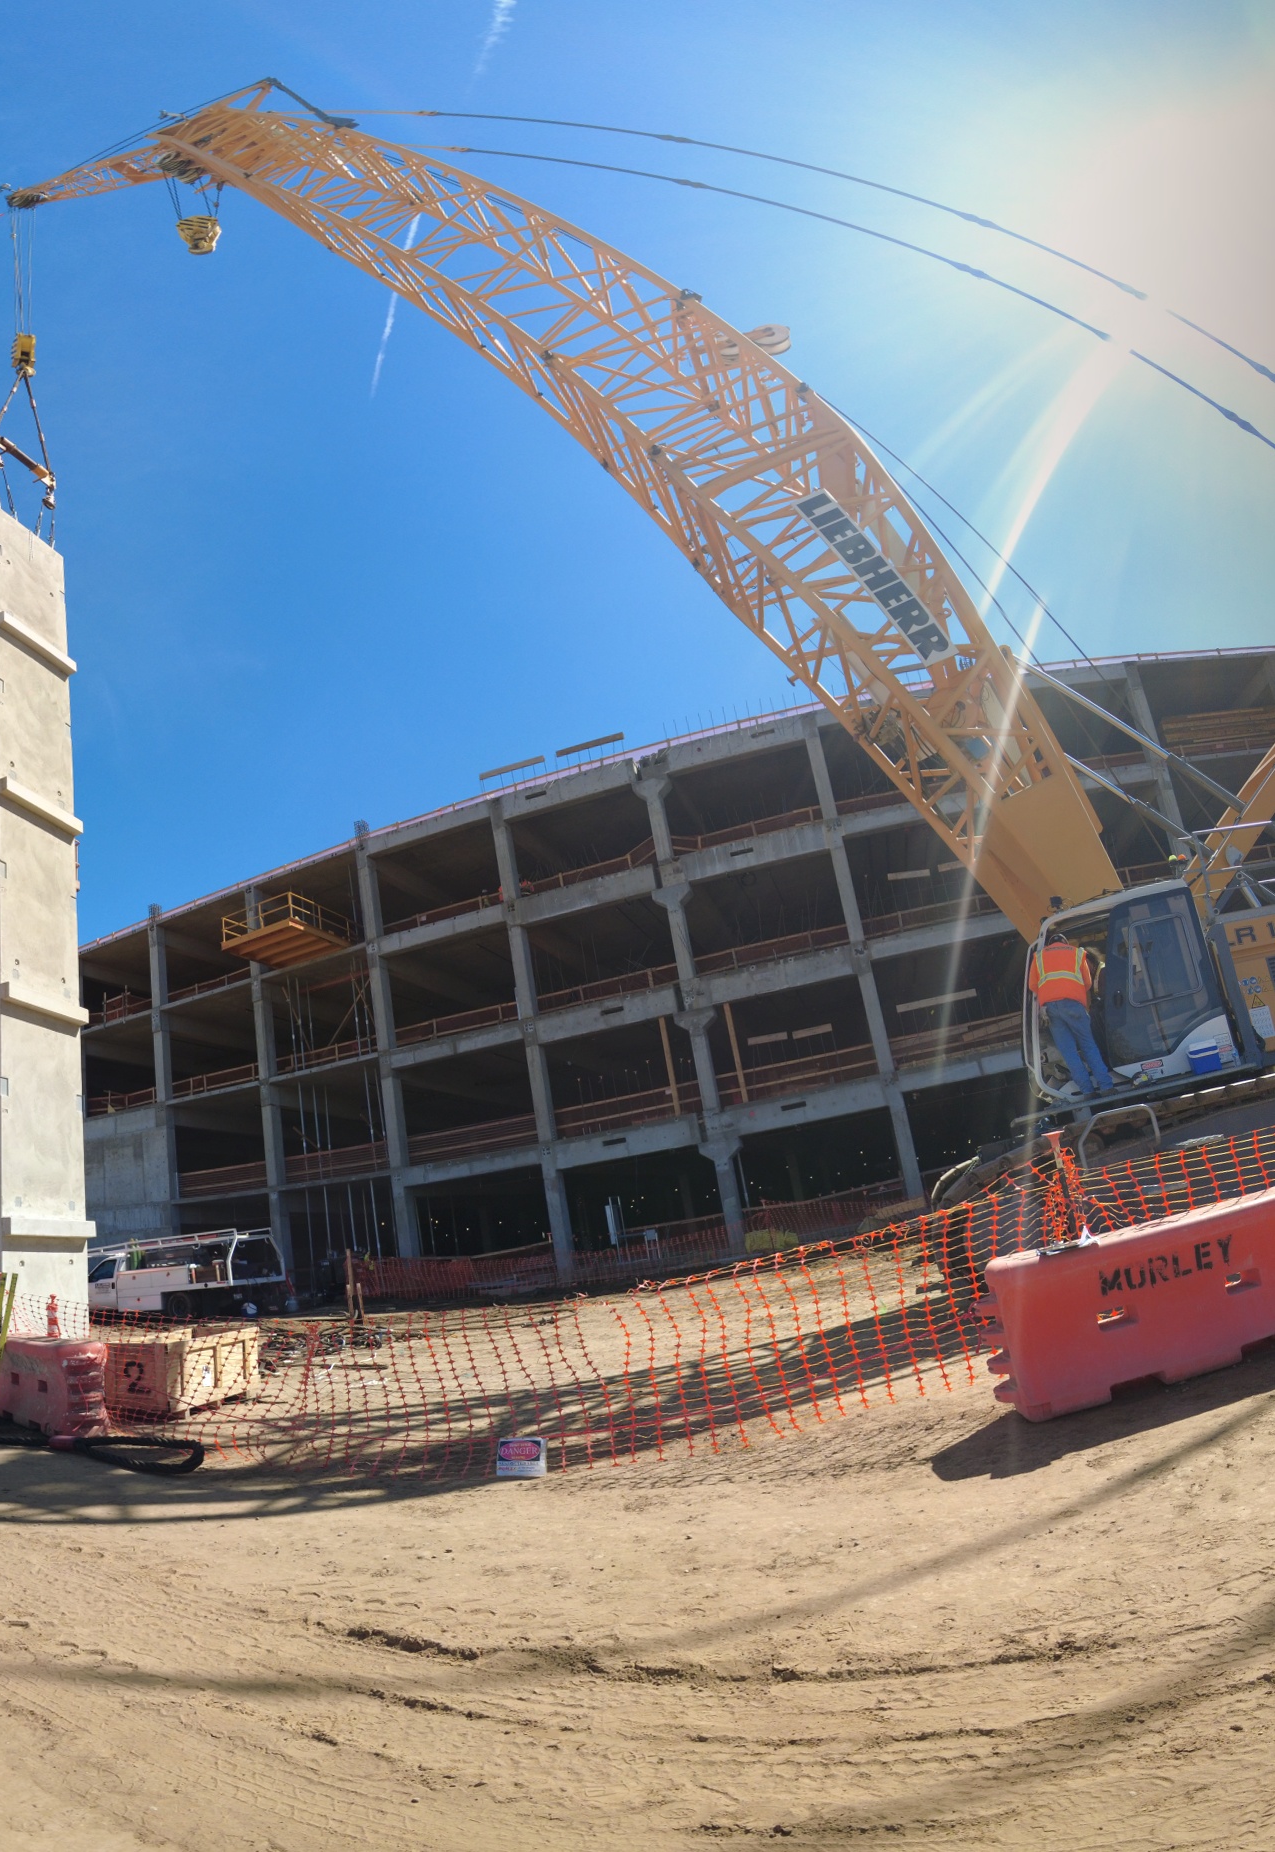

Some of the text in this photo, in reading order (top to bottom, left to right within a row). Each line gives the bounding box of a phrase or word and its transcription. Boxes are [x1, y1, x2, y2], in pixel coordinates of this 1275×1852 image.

[796, 492, 950, 661] LIEBHERR
[123, 1361, 151, 1394] 2
[500, 1446, 538, 1455] DANGER
